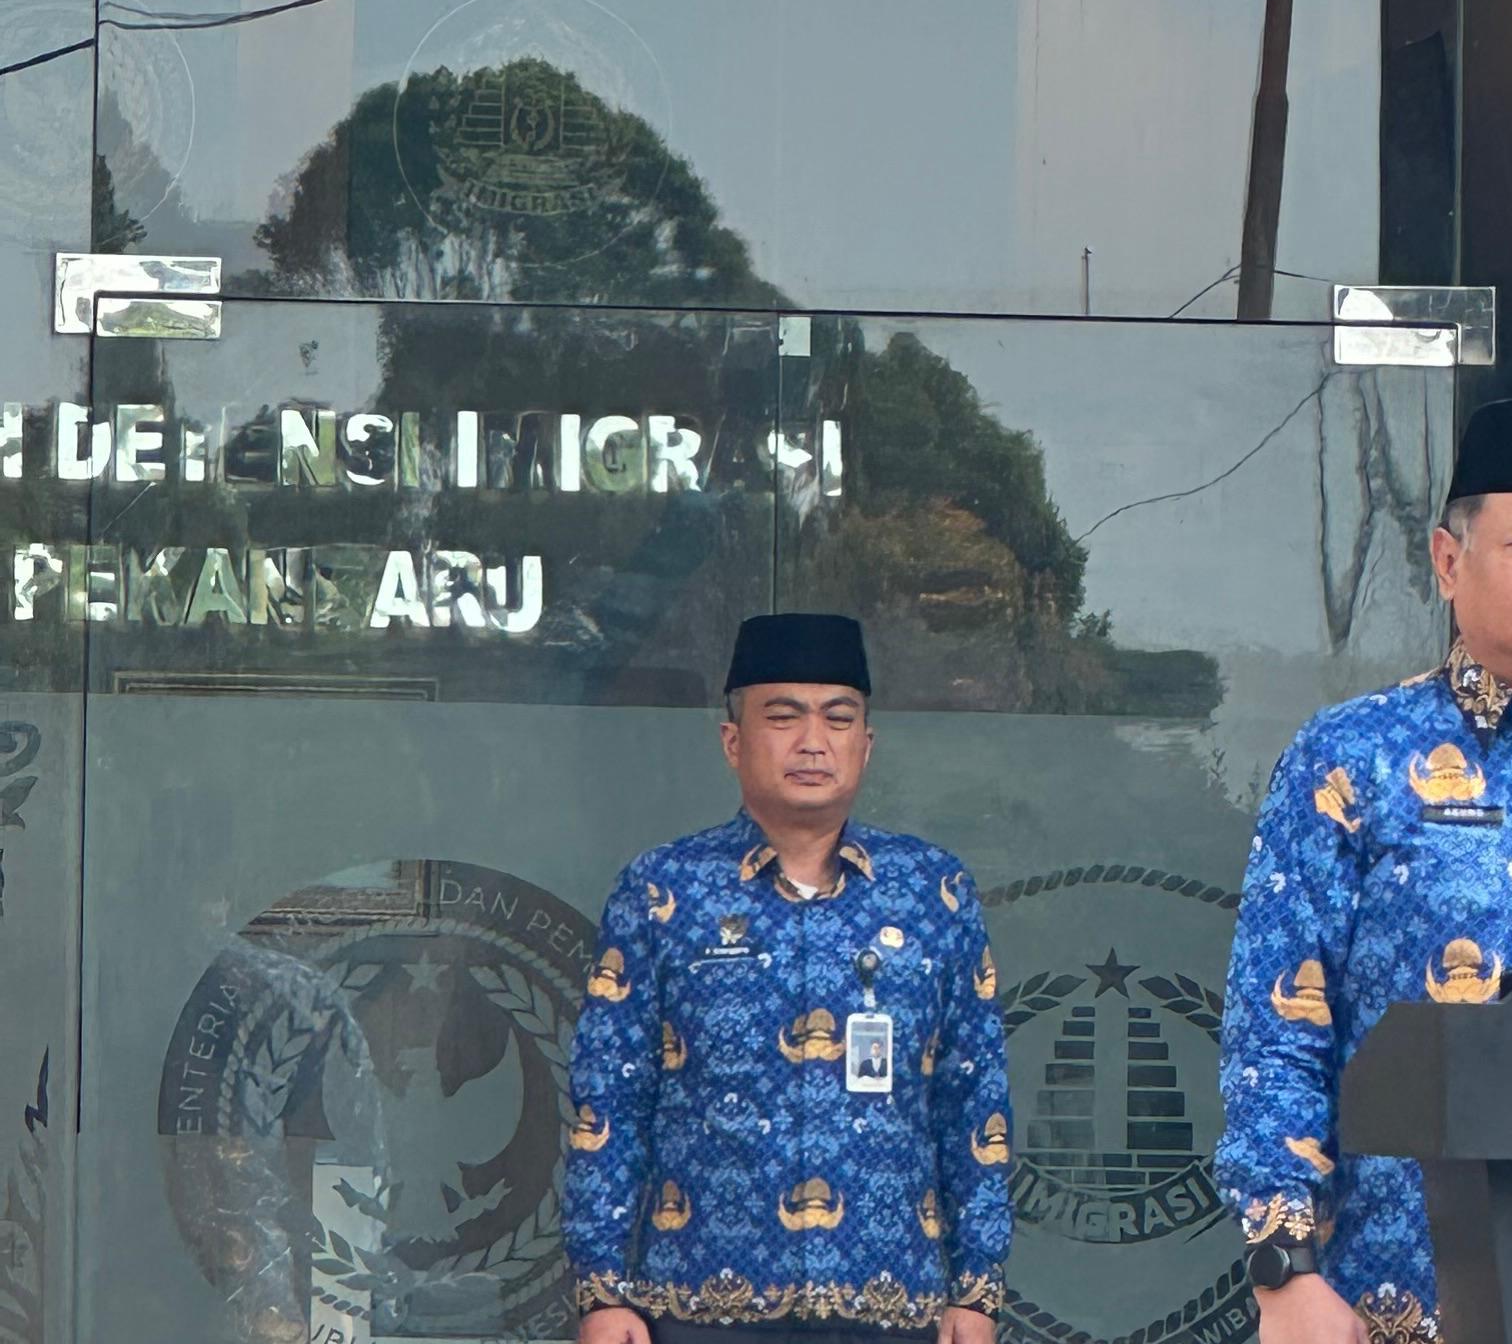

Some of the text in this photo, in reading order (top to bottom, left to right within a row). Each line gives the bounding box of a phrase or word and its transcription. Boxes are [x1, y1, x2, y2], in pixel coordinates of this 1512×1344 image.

[13, 542, 543, 634] PEKANARU
[438, 878, 520, 921] DAN
[1010, 1174, 1210, 1244] IMIGRASI
